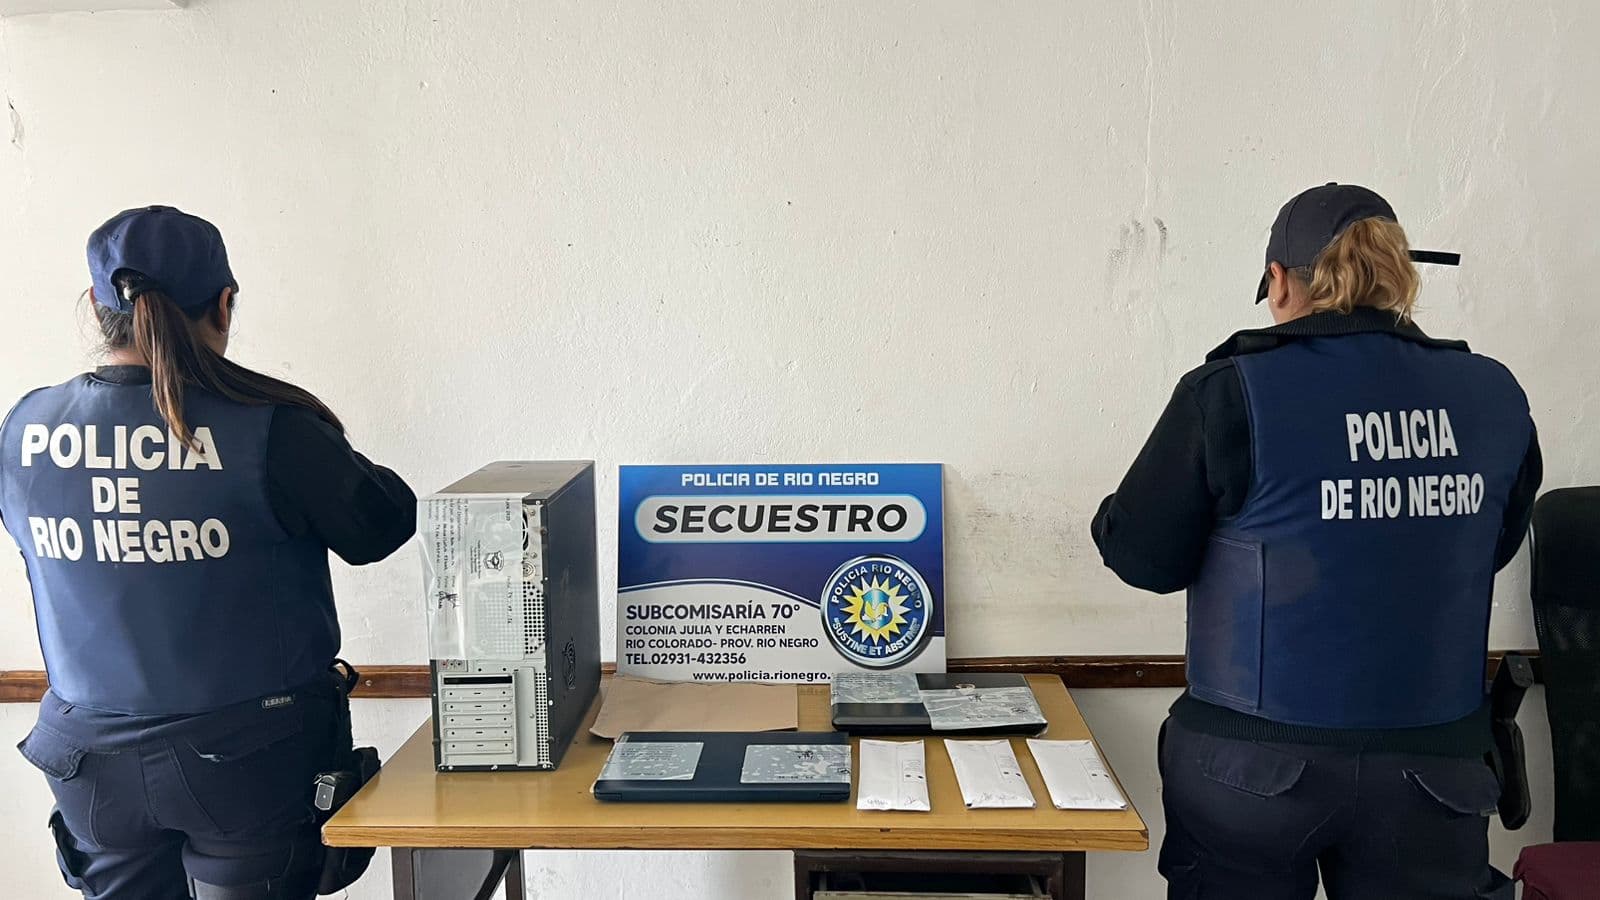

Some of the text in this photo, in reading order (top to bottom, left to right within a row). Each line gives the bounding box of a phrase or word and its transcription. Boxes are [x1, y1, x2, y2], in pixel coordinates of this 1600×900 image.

[21, 423, 224, 471] POLICIA
[1345, 408, 1459, 462] POLICIA
[681, 472, 879, 486] POLICIA DE RIO NEGRO
[91, 476, 141, 514] DE
[1320, 472, 1485, 520] DE RIO NEGRO
[652, 503, 908, 534] SECUESTRO
[28, 516, 230, 563] RIO NEGRO
[831, 564, 922, 608] POLICIA RIO NEGRO
[626, 600, 767, 620] SUBCOMISARÍA
[626, 624, 786, 635] COLONIA JULIA Y ECHARREN
[626, 637, 819, 649] RIO COLORADO- PROV. RIO NEGRO
[626, 652, 747, 665] TEL.02931-432356
[869, 646, 882, 655] ET
